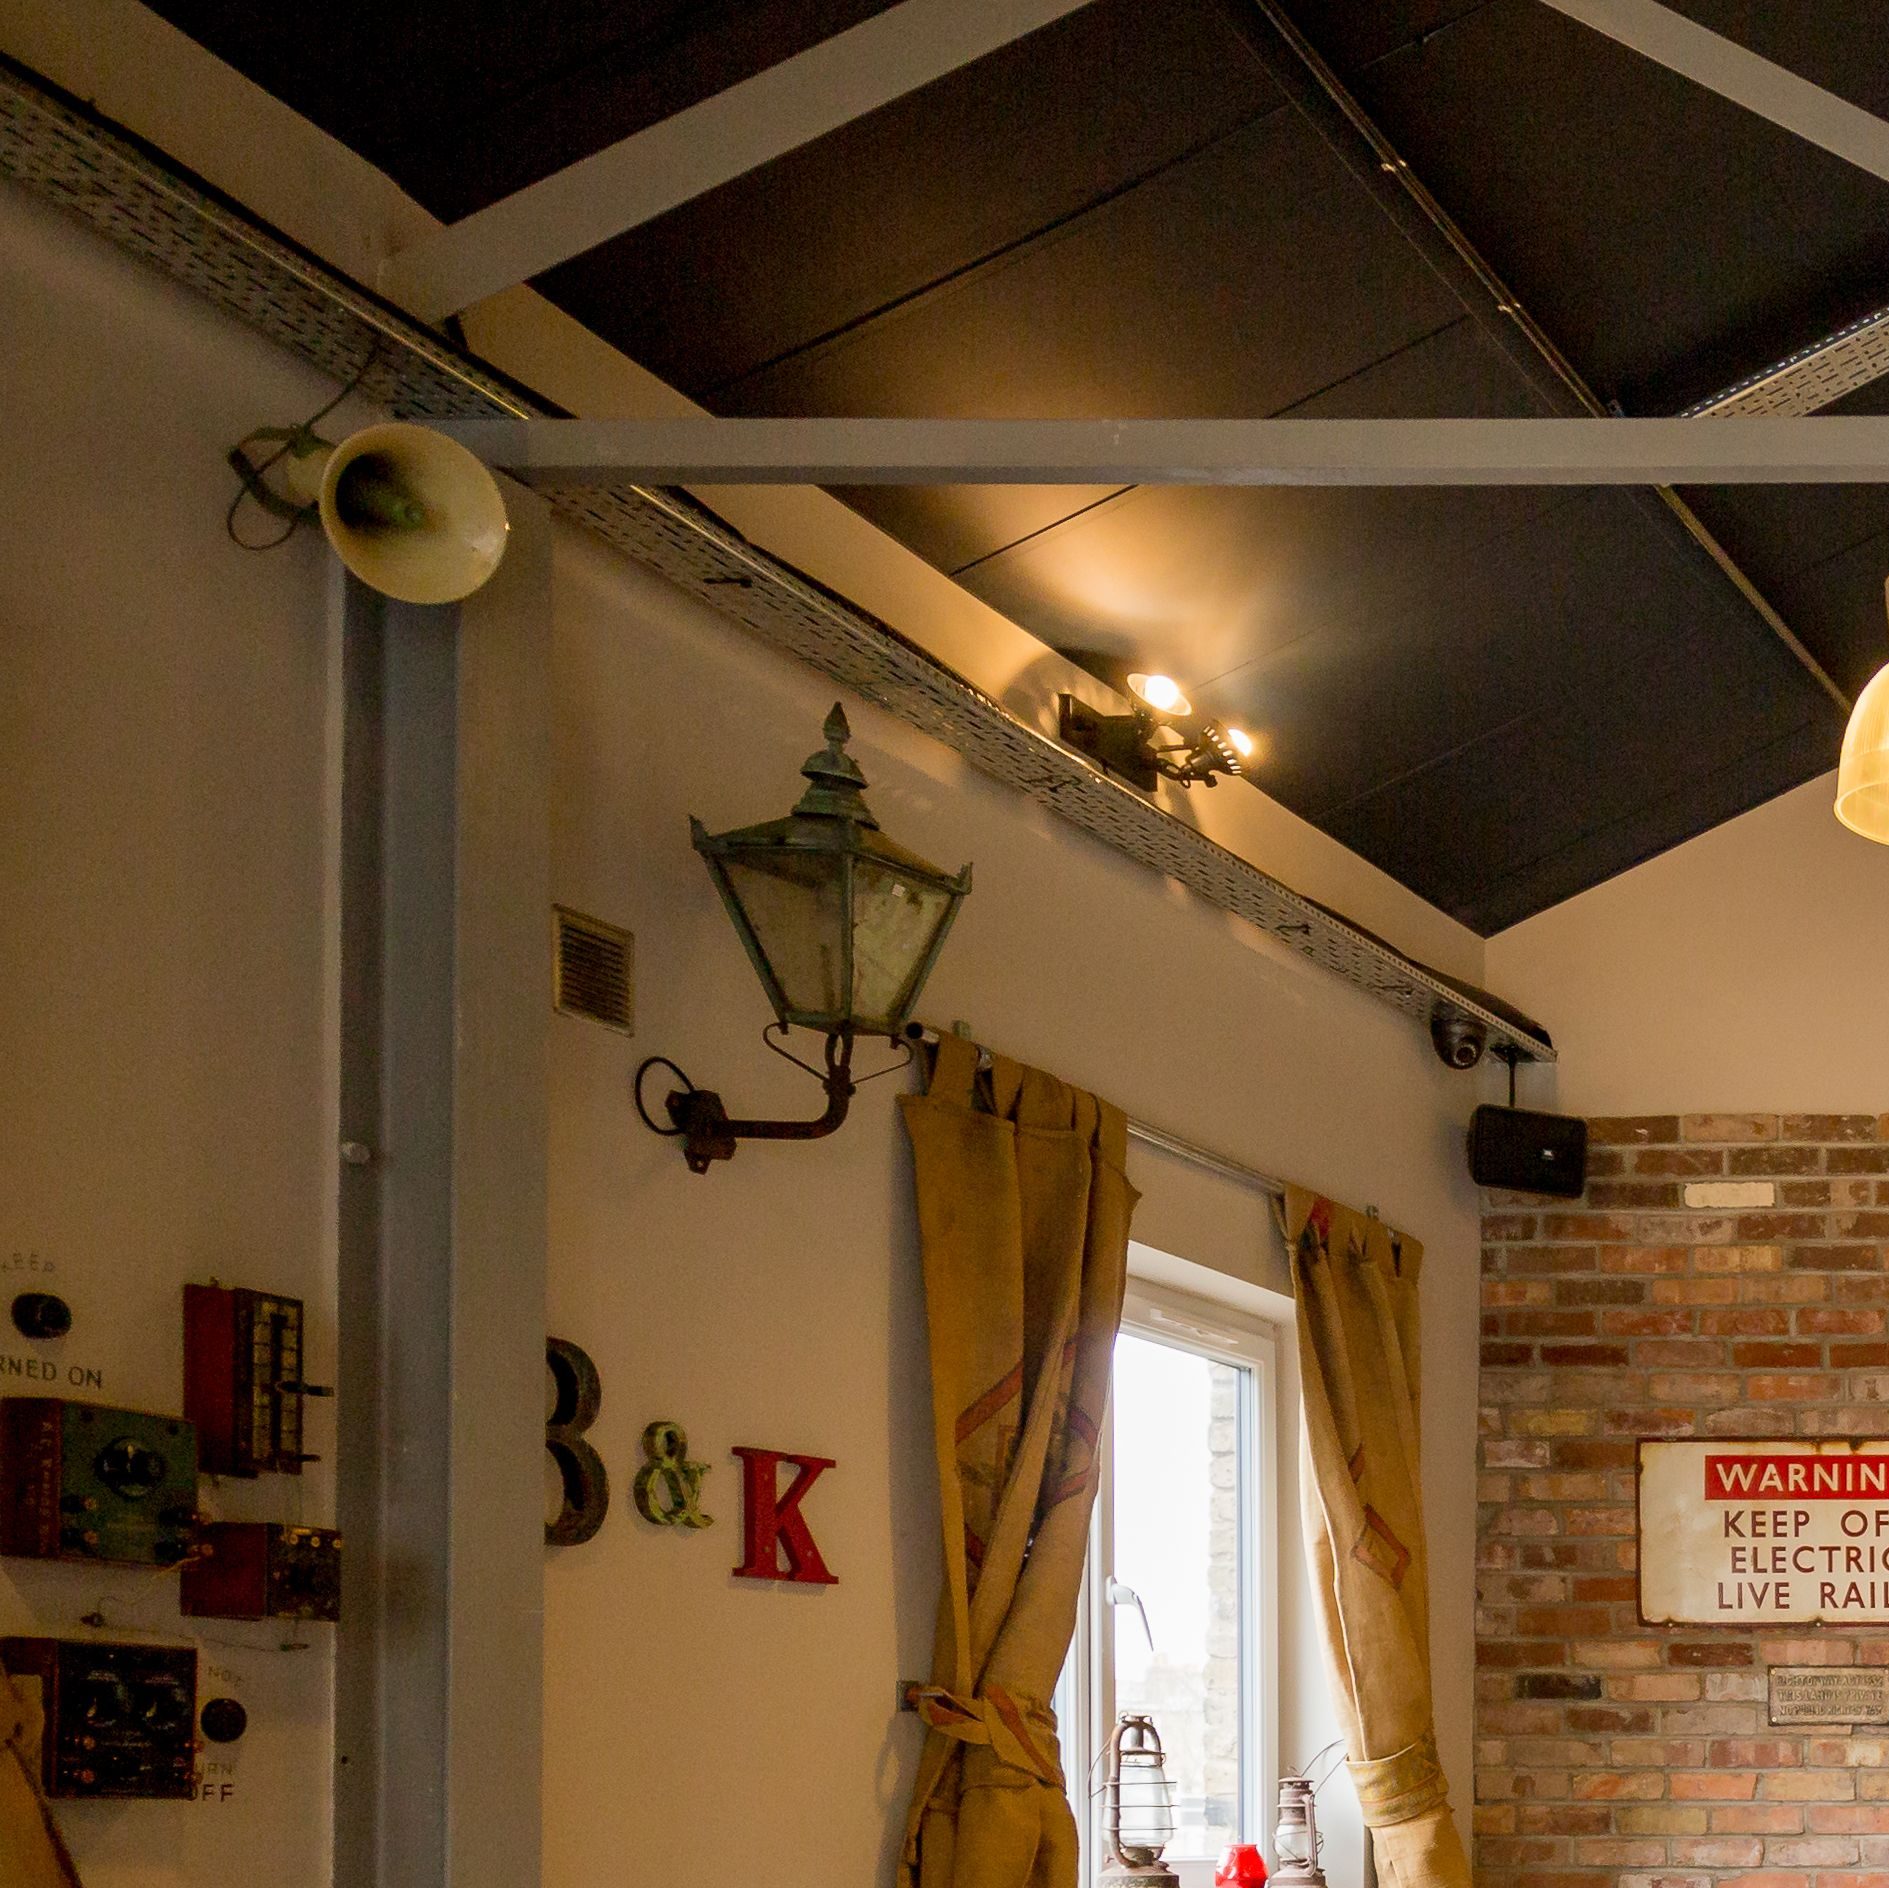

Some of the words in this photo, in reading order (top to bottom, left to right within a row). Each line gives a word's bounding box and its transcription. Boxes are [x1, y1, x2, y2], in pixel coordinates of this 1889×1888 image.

[68, 1366, 102, 1389] ON
[545, 1336, 608, 1546] B
[633, 1420, 714, 1529] &
[731, 1446, 839, 1574] K
[1724, 1510, 1810, 1538] KEEP
[1718, 1582, 1790, 1609] LIVE
